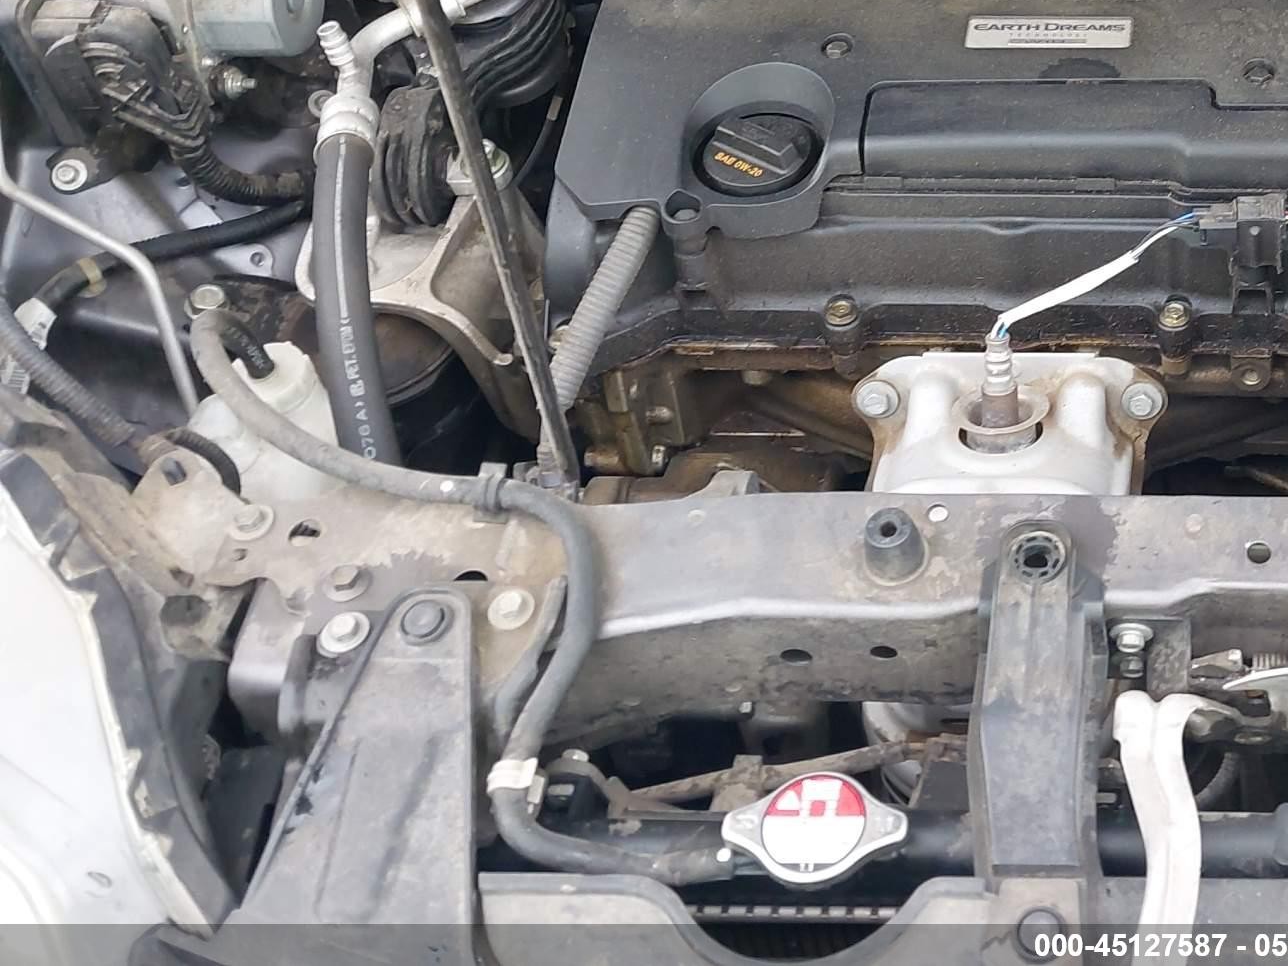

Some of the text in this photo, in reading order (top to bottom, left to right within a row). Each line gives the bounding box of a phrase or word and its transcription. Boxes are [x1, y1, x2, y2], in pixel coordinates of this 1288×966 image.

[974, 22, 1126, 31] EARTH DREAMS
[733, 160, 763, 177] 0W-20
